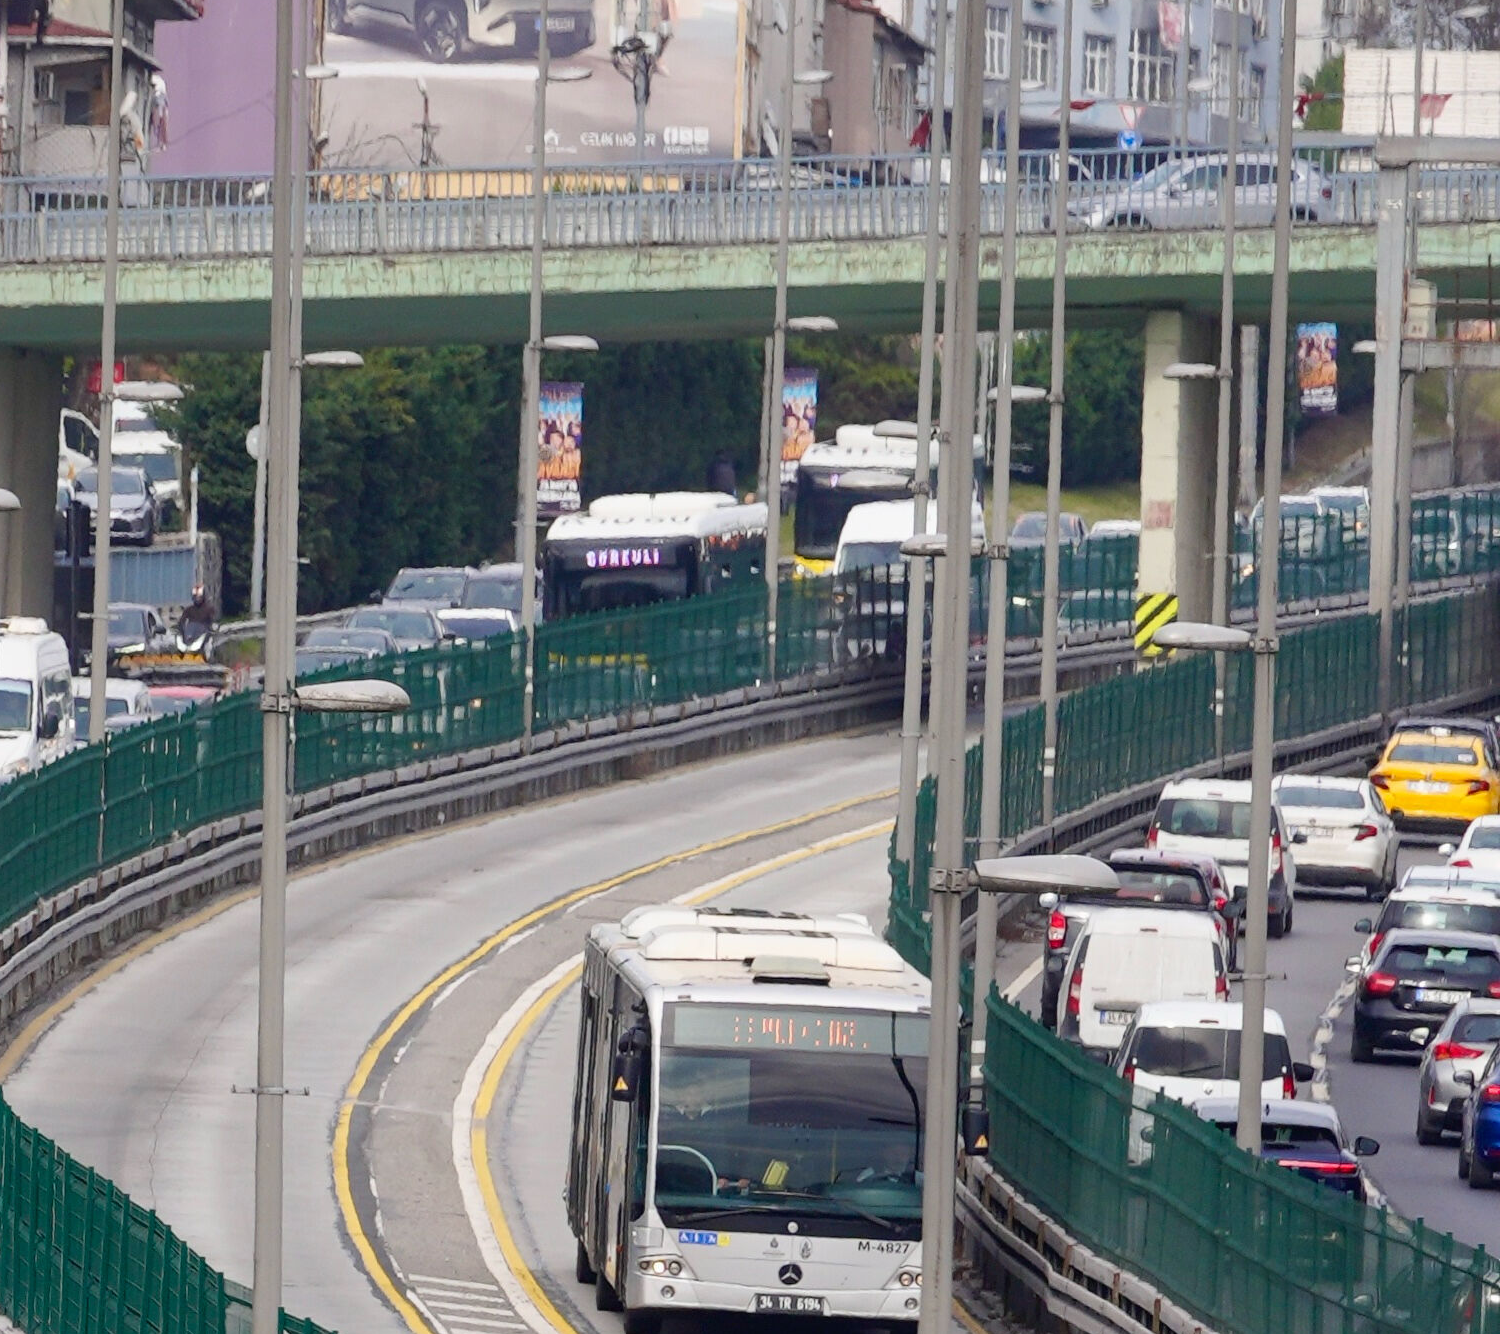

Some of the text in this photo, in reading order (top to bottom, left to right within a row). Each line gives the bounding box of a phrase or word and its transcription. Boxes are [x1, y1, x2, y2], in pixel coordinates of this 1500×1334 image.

[857, 1240, 910, 1255] M-4827
[759, 1297, 773, 1308] 34
[779, 1298, 791, 1309] TR
